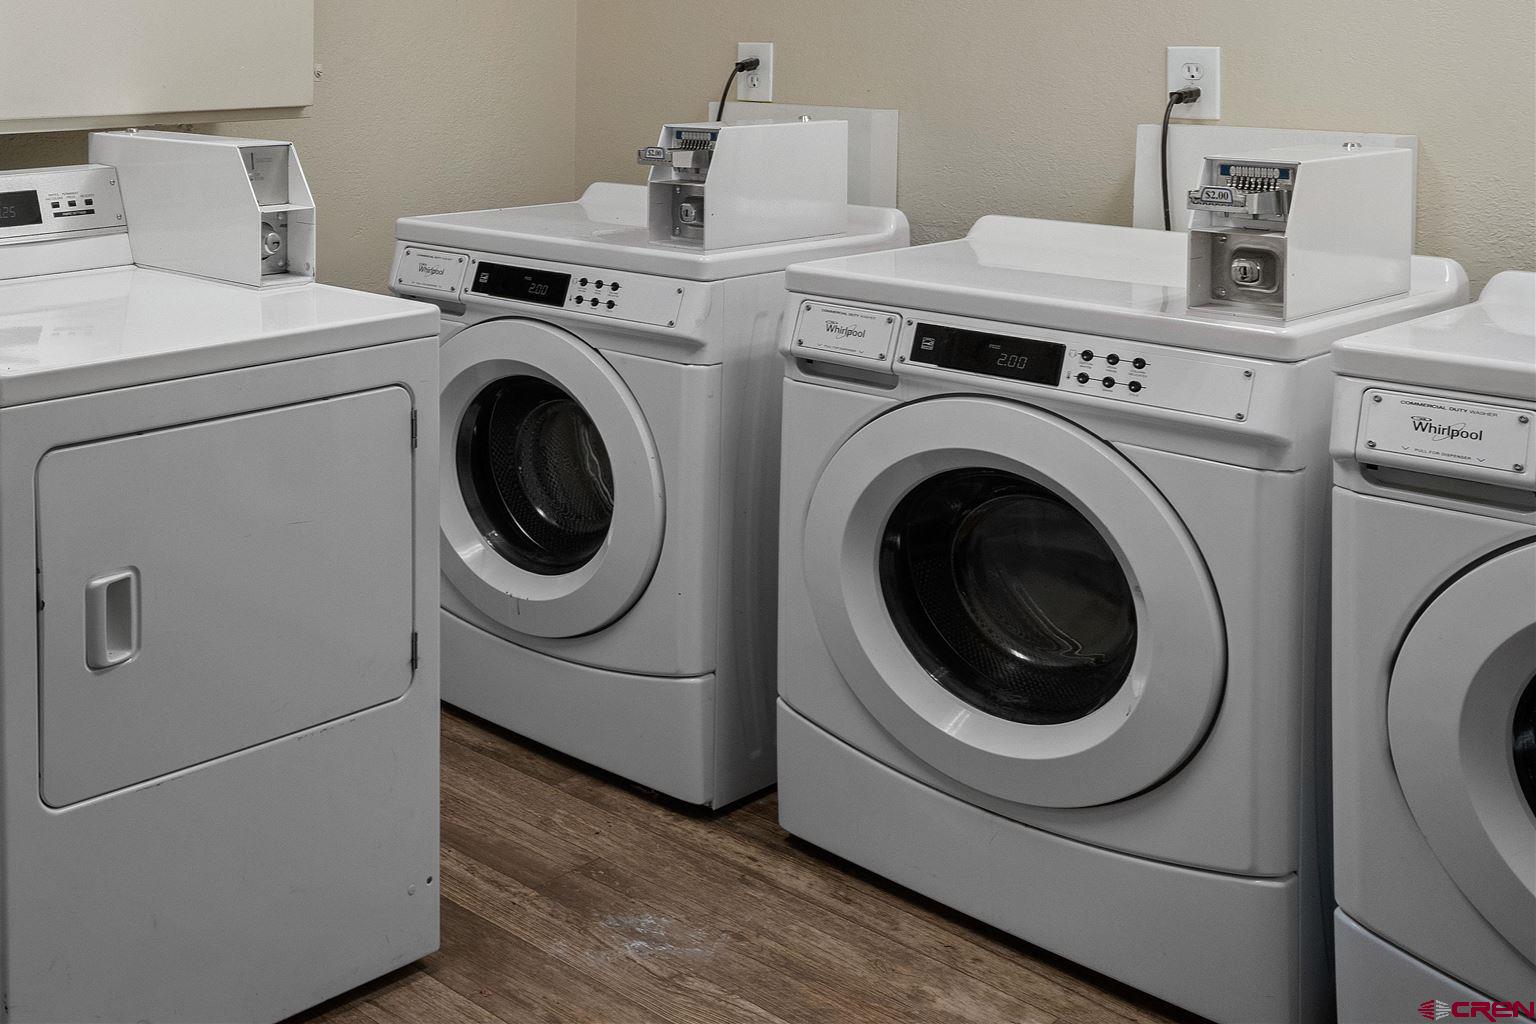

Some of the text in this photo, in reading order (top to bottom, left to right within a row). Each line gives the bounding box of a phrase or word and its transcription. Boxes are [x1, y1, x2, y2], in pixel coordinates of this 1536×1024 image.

[1205, 190, 1229, 200] $2.00
[825, 323, 866, 338] Whirlpool
[996, 352, 1028, 370] 2.00
[1400, 400, 1447, 410] COMMERCIAL
[1412, 420, 1483, 441] Whirlpool
